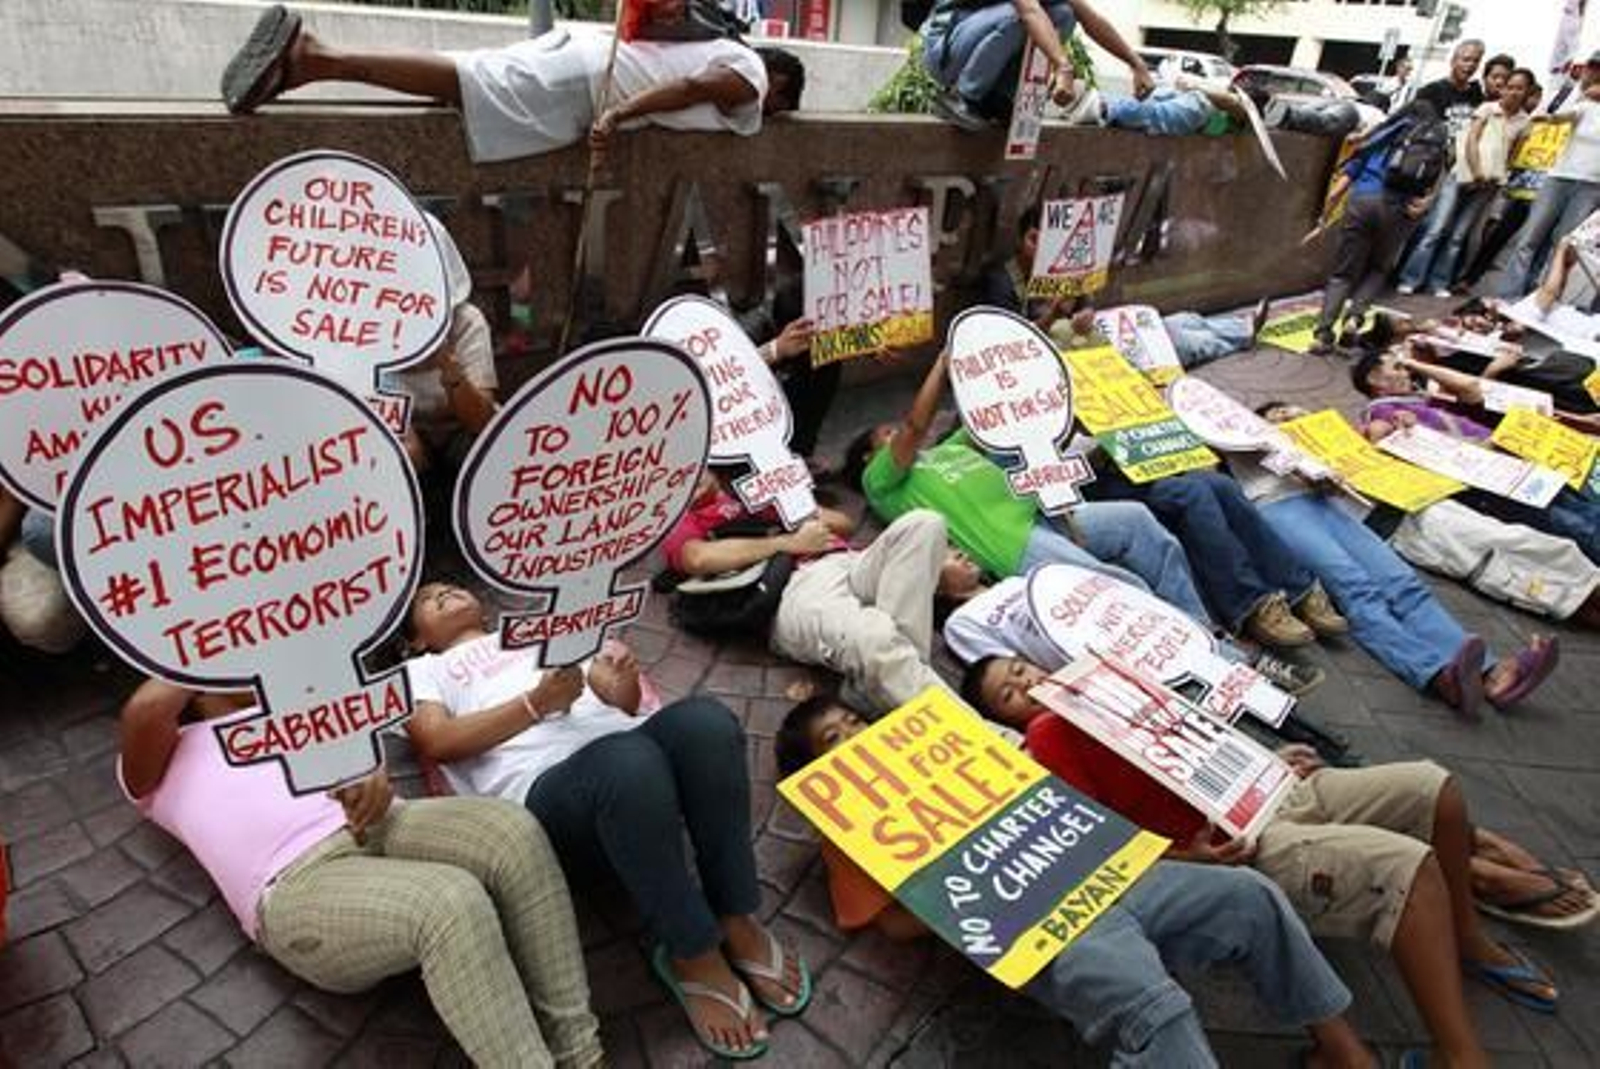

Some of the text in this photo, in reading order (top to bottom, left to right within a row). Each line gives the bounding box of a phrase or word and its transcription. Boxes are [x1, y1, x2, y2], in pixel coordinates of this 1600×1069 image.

[304, 178, 373, 208] OUR
[1046, 203, 1074, 231] WE
[267, 236, 398, 273] FUTURE
[832, 255, 886, 294] NOT
[254, 270, 436, 319] IS NOT FOR
[815, 292, 849, 324] FOR
[952, 338, 1044, 384] PHILIPPINES
[993, 370, 1019, 390] IS
[568, 364, 633, 415] NO
[525, 425, 570, 457] TO
[970, 400, 1009, 433] NOT
[511, 440, 667, 498] FOREIGN
[1011, 461, 1087, 493] GABRIELA
[487, 466, 669, 528] OWNERSHIP
[485, 524, 547, 554] OUR
[557, 502, 645, 546] LAND
[102, 560, 171, 617] #1
[163, 529, 407, 667] TERRORIST!
[505, 595, 637, 643] GABRIELA
[226, 683, 403, 761] GABRIELA
[880, 704, 943, 753] NOT
[907, 730, 973, 779] FOR
[797, 741, 910, 834] PH
[872, 743, 1030, 863] SALE!
[944, 786, 1068, 956] NO TO CHARTER
